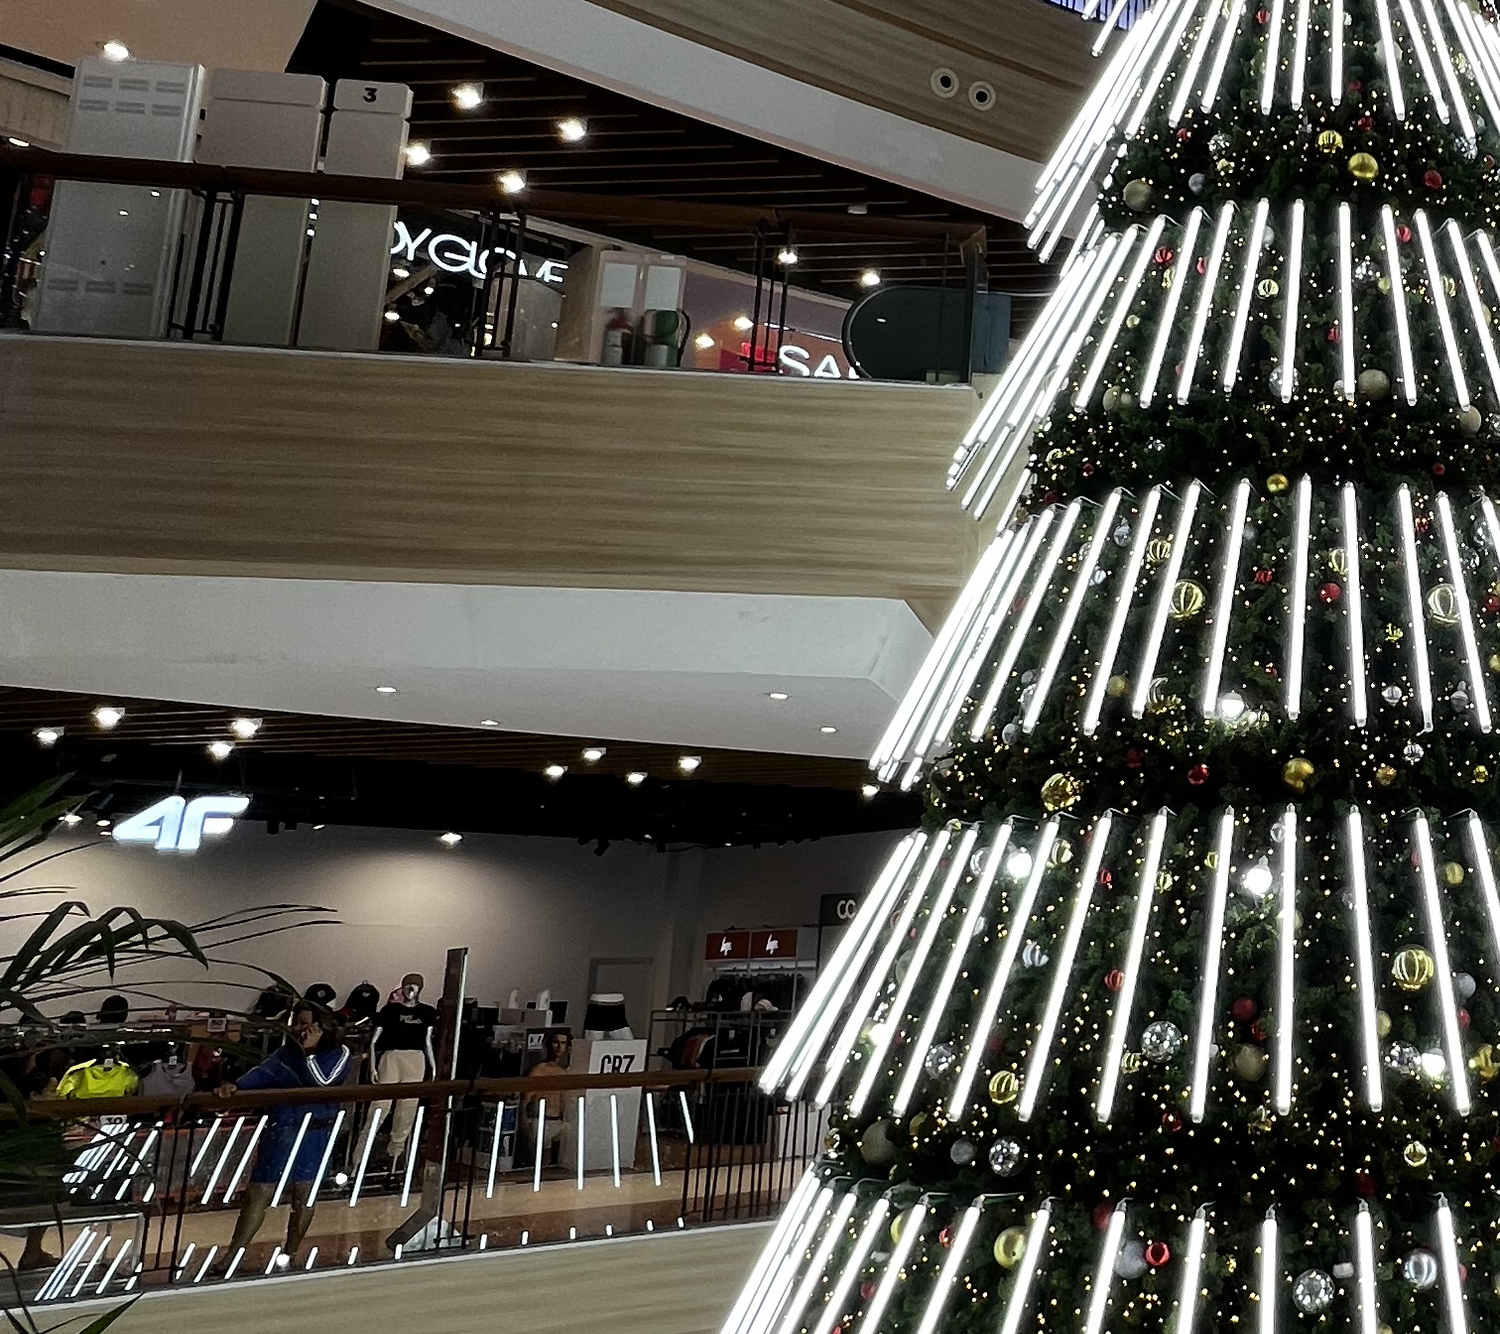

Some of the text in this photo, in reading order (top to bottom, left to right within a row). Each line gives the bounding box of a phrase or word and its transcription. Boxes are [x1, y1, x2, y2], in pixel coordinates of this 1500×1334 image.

[362, 87, 378, 103] 3
[778, 344, 860, 379] SA
[112, 795, 250, 851] 4F
